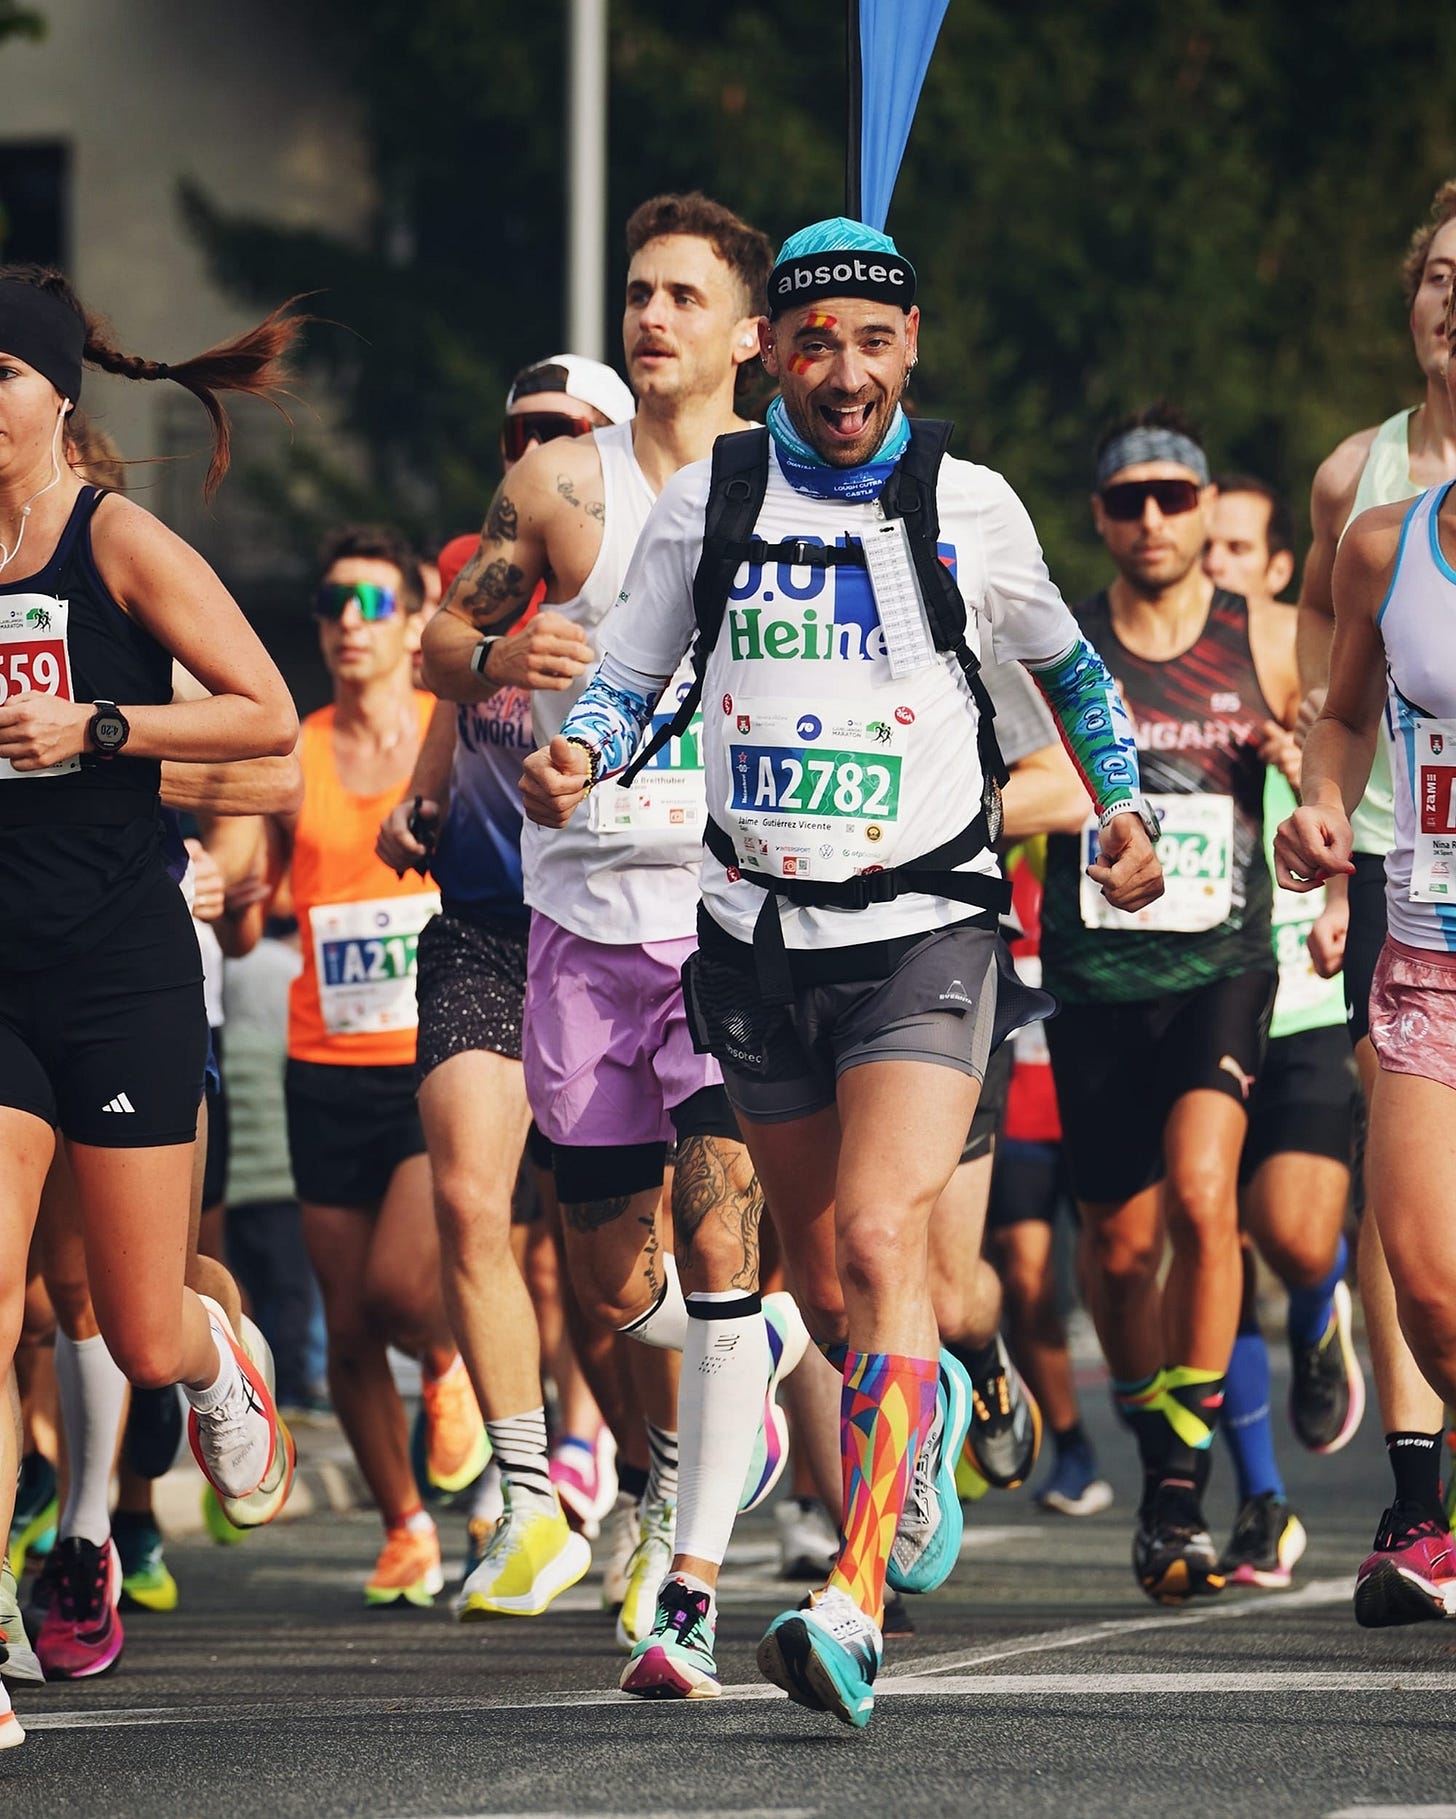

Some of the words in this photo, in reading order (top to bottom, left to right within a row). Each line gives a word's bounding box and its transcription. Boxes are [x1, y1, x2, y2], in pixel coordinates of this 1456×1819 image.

[777, 259, 905, 294] absotec
[845, 489, 874, 497] CASTLE
[754, 756, 891, 816] A2782
[738, 816, 759, 826] Jaime
[762, 817, 797, 829] Gutiérrez
[798, 820, 832, 831] Vicente
[1433, 840, 1450, 849] Nina
